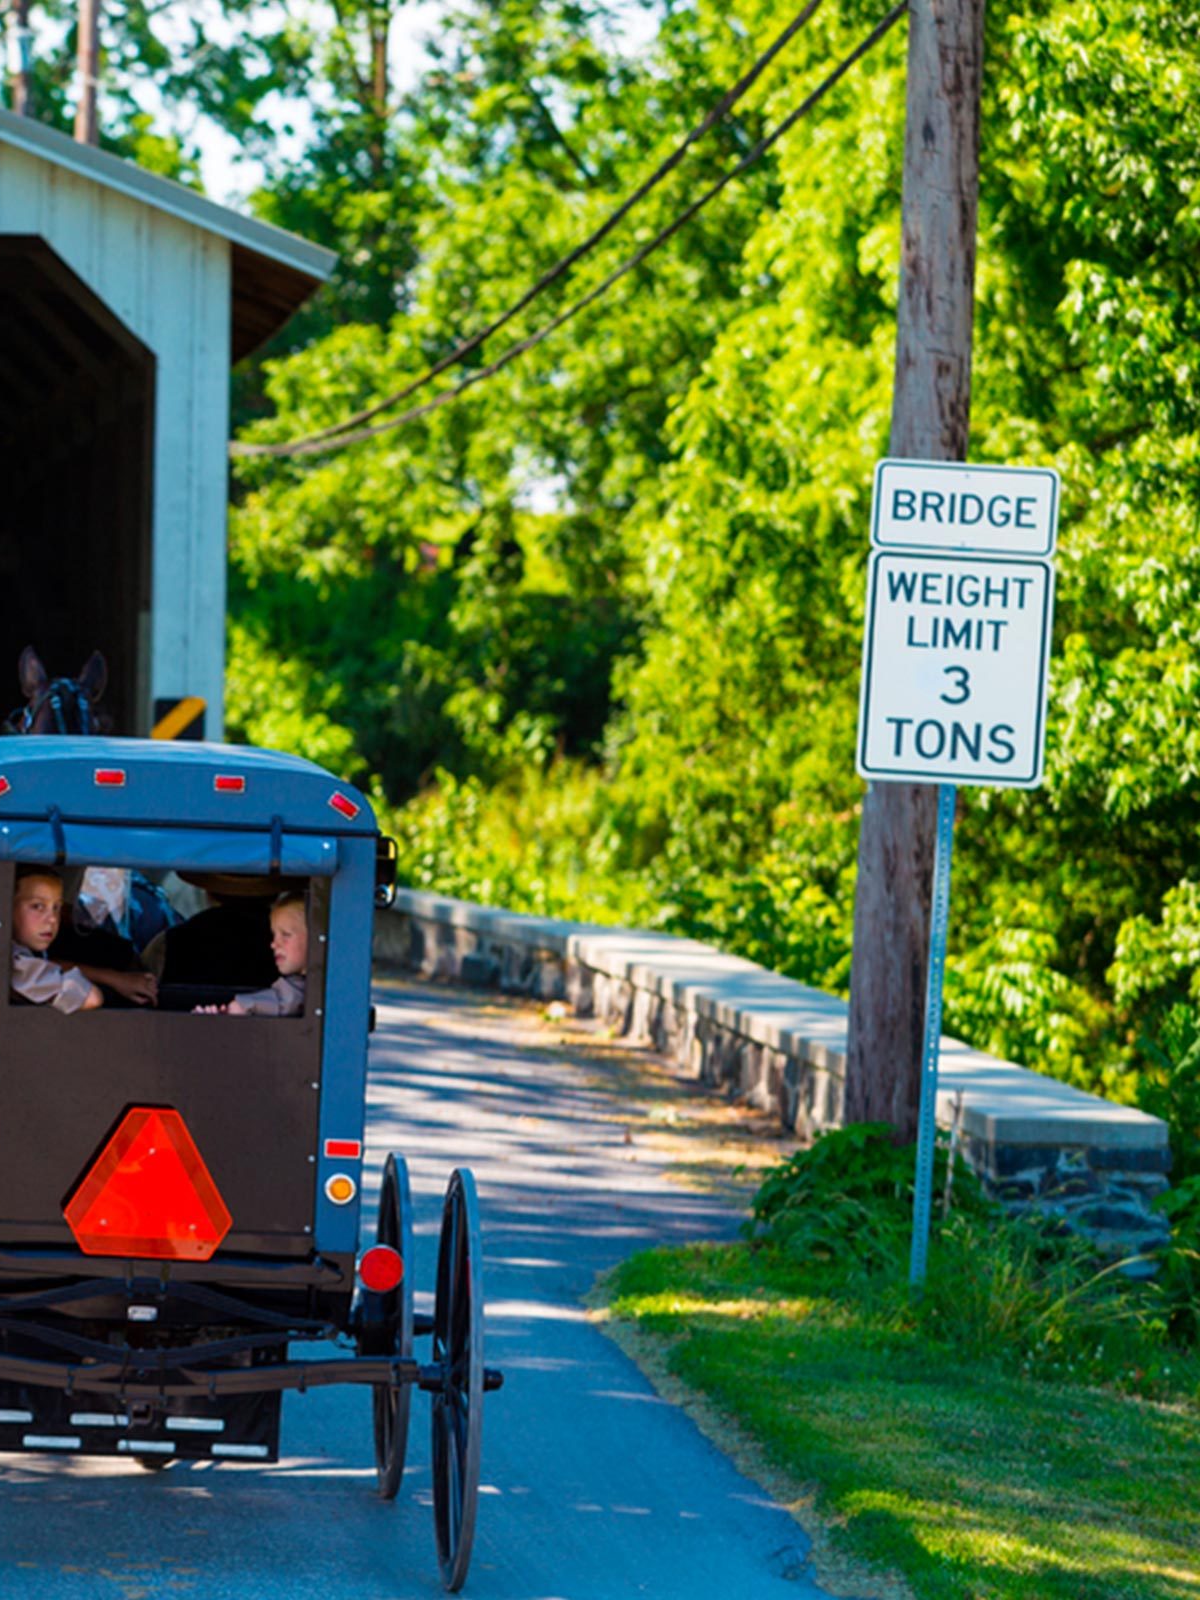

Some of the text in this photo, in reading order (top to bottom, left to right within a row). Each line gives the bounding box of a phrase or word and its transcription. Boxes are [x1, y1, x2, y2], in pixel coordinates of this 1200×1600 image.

[891, 489, 1037, 529] BRIDGE
[887, 570, 1034, 610] WEIGHT
[906, 615, 1008, 652] LIMIT
[940, 665, 971, 705] 3
[885, 717, 1016, 765] TONS
